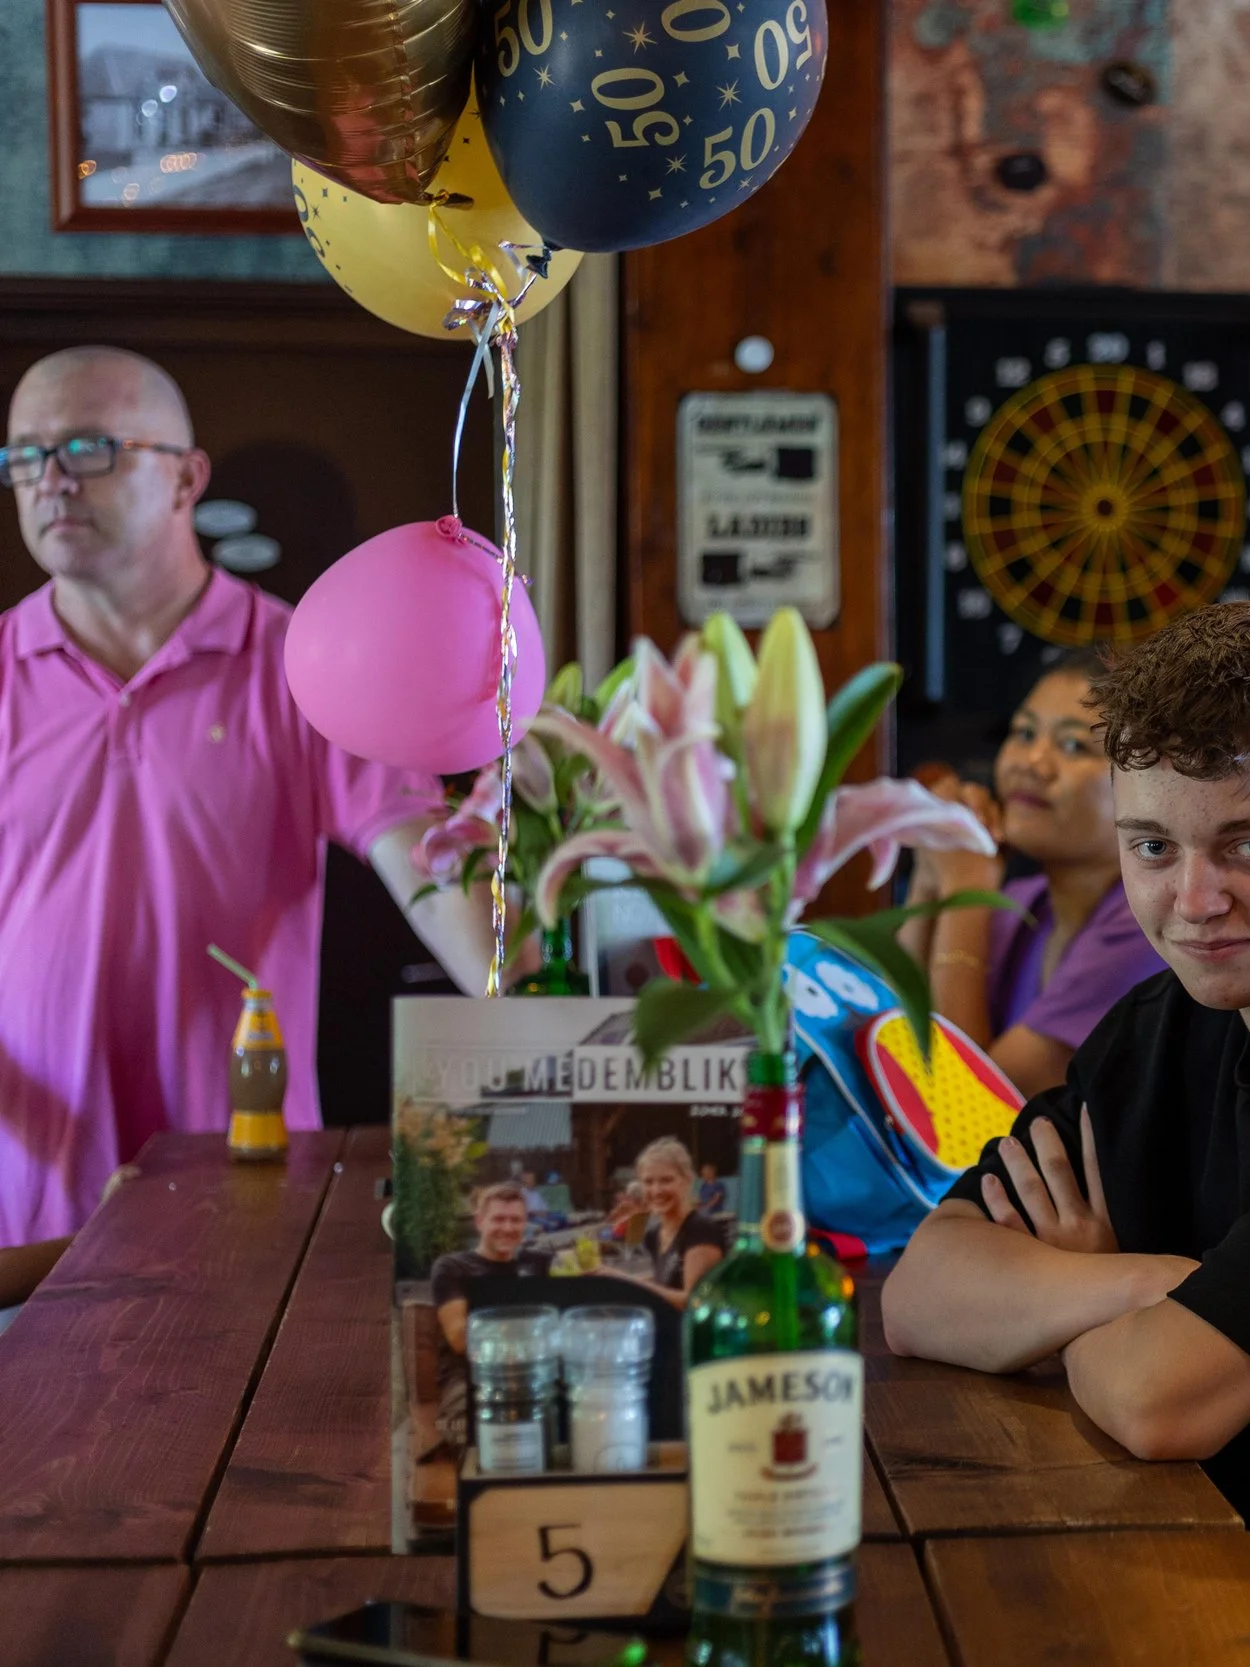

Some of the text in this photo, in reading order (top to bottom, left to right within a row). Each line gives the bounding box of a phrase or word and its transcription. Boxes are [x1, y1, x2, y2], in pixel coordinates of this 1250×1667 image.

[494, 0, 553, 77] 50
[754, 0, 812, 90] 50
[591, 67, 680, 148] 50
[699, 107, 775, 190] 50
[537, 1522, 593, 1600] 5
